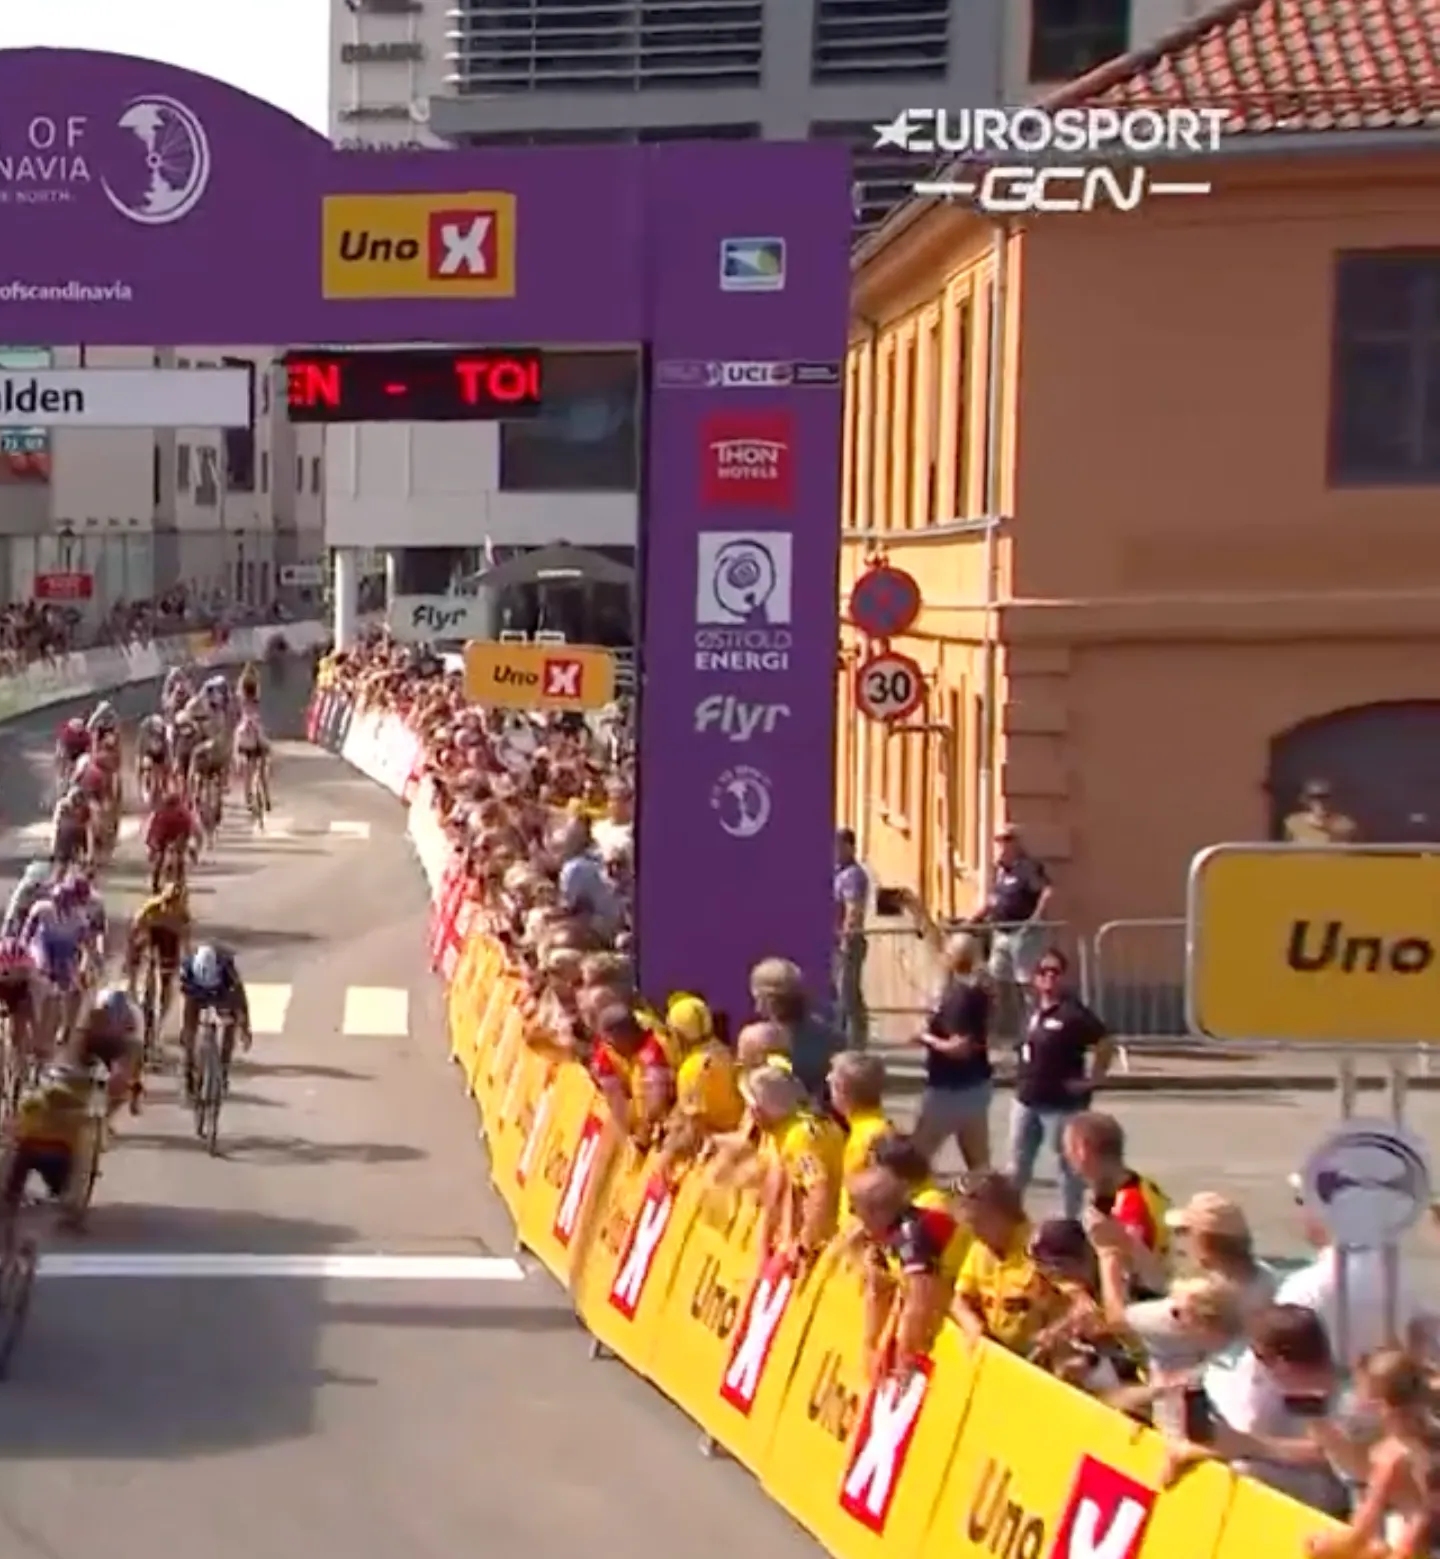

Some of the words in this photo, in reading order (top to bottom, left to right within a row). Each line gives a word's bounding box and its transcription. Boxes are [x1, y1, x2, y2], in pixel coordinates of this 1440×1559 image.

[28, 117, 88, 150] OF
[339, 230, 420, 262] Uno
[437, 214, 492, 275] X
[727, 365, 768, 382] UCI
[716, 442, 780, 465] THON
[717, 466, 779, 480] HOTELS
[411, 604, 468, 632] Flyr
[492, 664, 539, 687] Uno
[546, 661, 580, 695] X
[694, 651, 789, 671] ENERGI
[867, 670, 911, 704] 30
[693, 693, 792, 742] Flyr
[1287, 920, 1434, 975] Uno
[690, 1253, 740, 1341] Uno
[725, 1272, 792, 1401] X
[807, 1349, 859, 1443] Uno
[845, 1369, 928, 1520] X
[967, 1457, 1046, 1559] Uno
